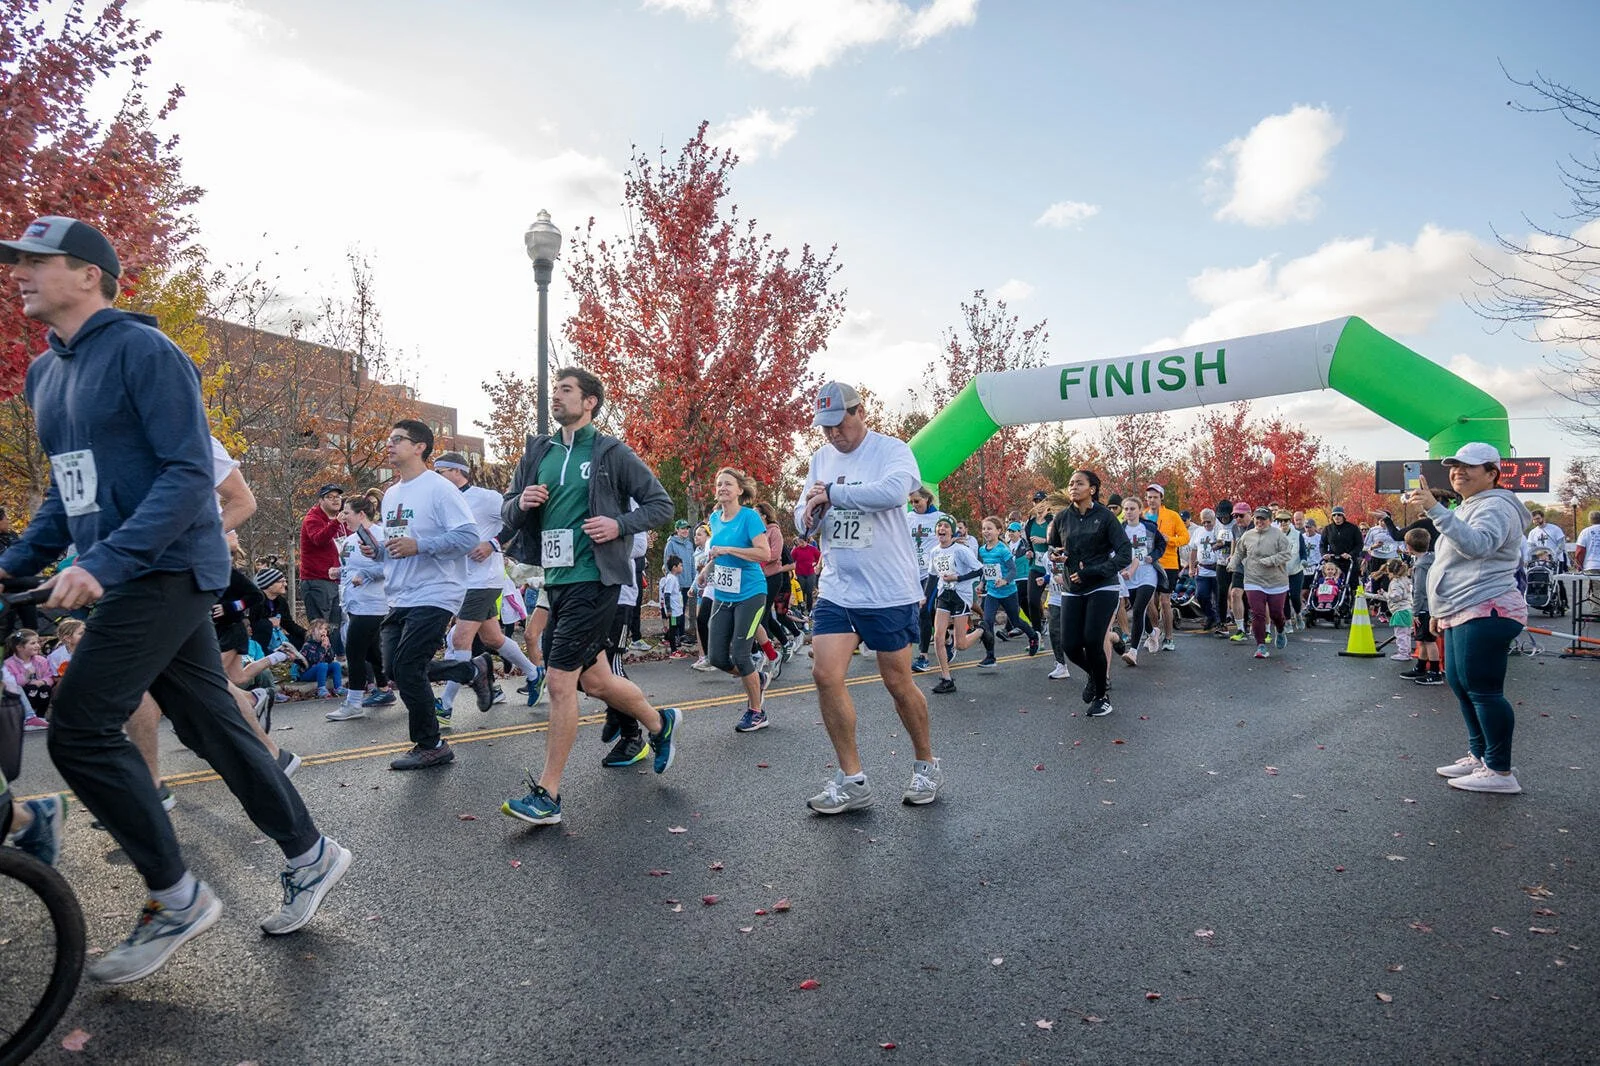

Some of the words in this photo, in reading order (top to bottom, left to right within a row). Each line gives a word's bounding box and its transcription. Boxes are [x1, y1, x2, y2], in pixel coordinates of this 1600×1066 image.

[1059, 348, 1227, 400] FINISH
[833, 520, 860, 541] 212
[544, 540, 561, 559] 125
[717, 572, 733, 587] 235
